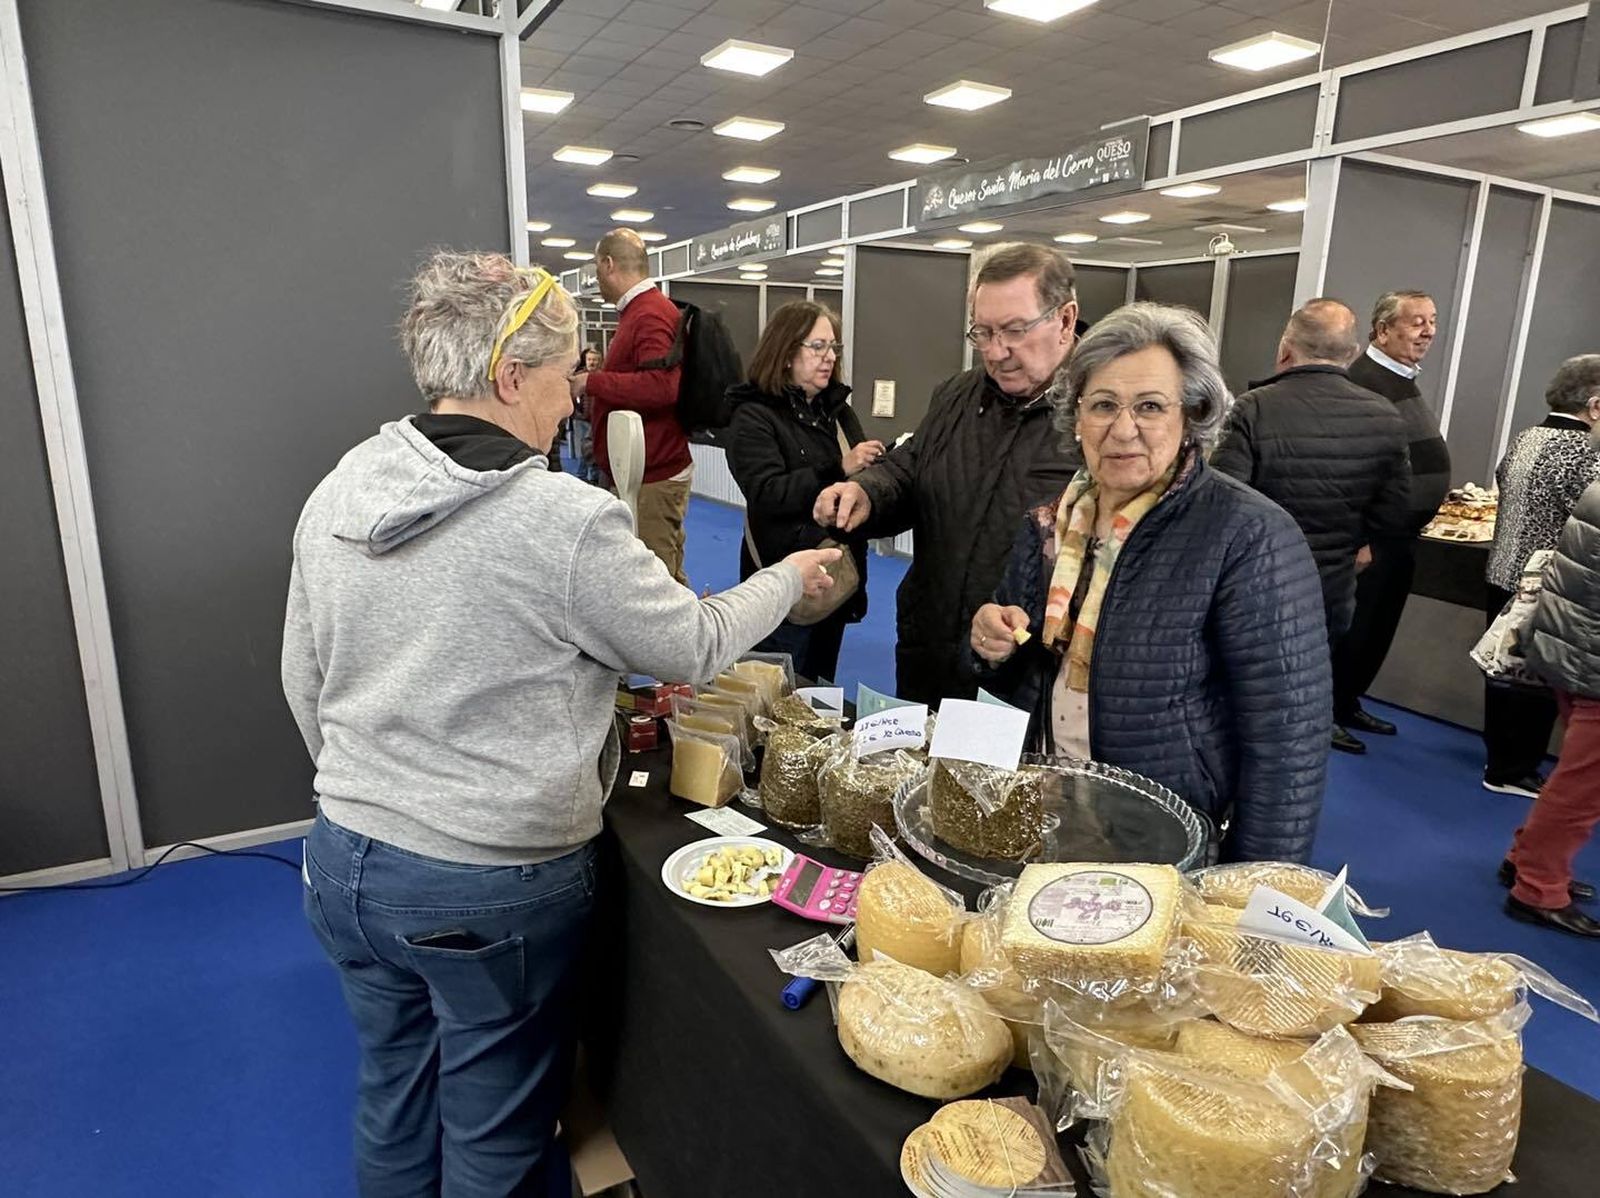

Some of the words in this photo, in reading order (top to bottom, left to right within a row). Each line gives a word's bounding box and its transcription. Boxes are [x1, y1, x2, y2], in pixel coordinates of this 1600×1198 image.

[1097, 141, 1131, 162] QUESO
[978, 175, 1005, 201] Santa
[1043, 157, 1061, 180] del
[1062, 154, 1094, 178] Cerro
